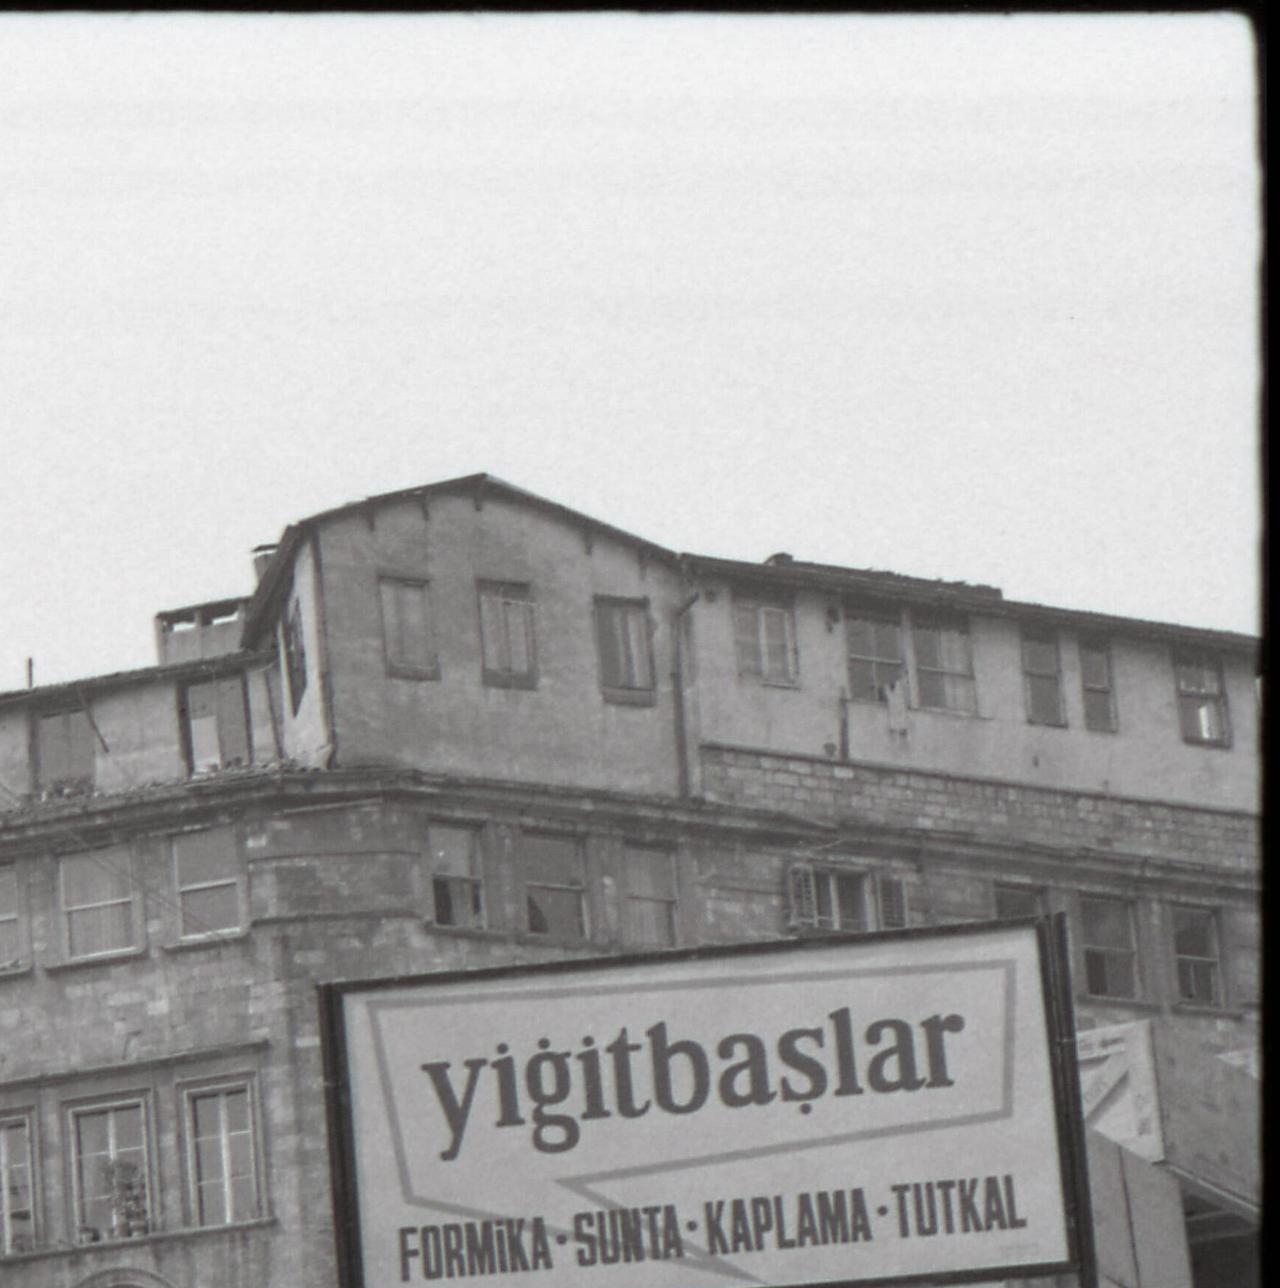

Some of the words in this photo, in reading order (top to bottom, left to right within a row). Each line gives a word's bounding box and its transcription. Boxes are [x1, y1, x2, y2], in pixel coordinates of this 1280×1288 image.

[572, 1204, 686, 1268] SUNTA
[703, 1188, 874, 1256] KAPLAMA
[890, 1175, 1028, 1238] TUTKAL
